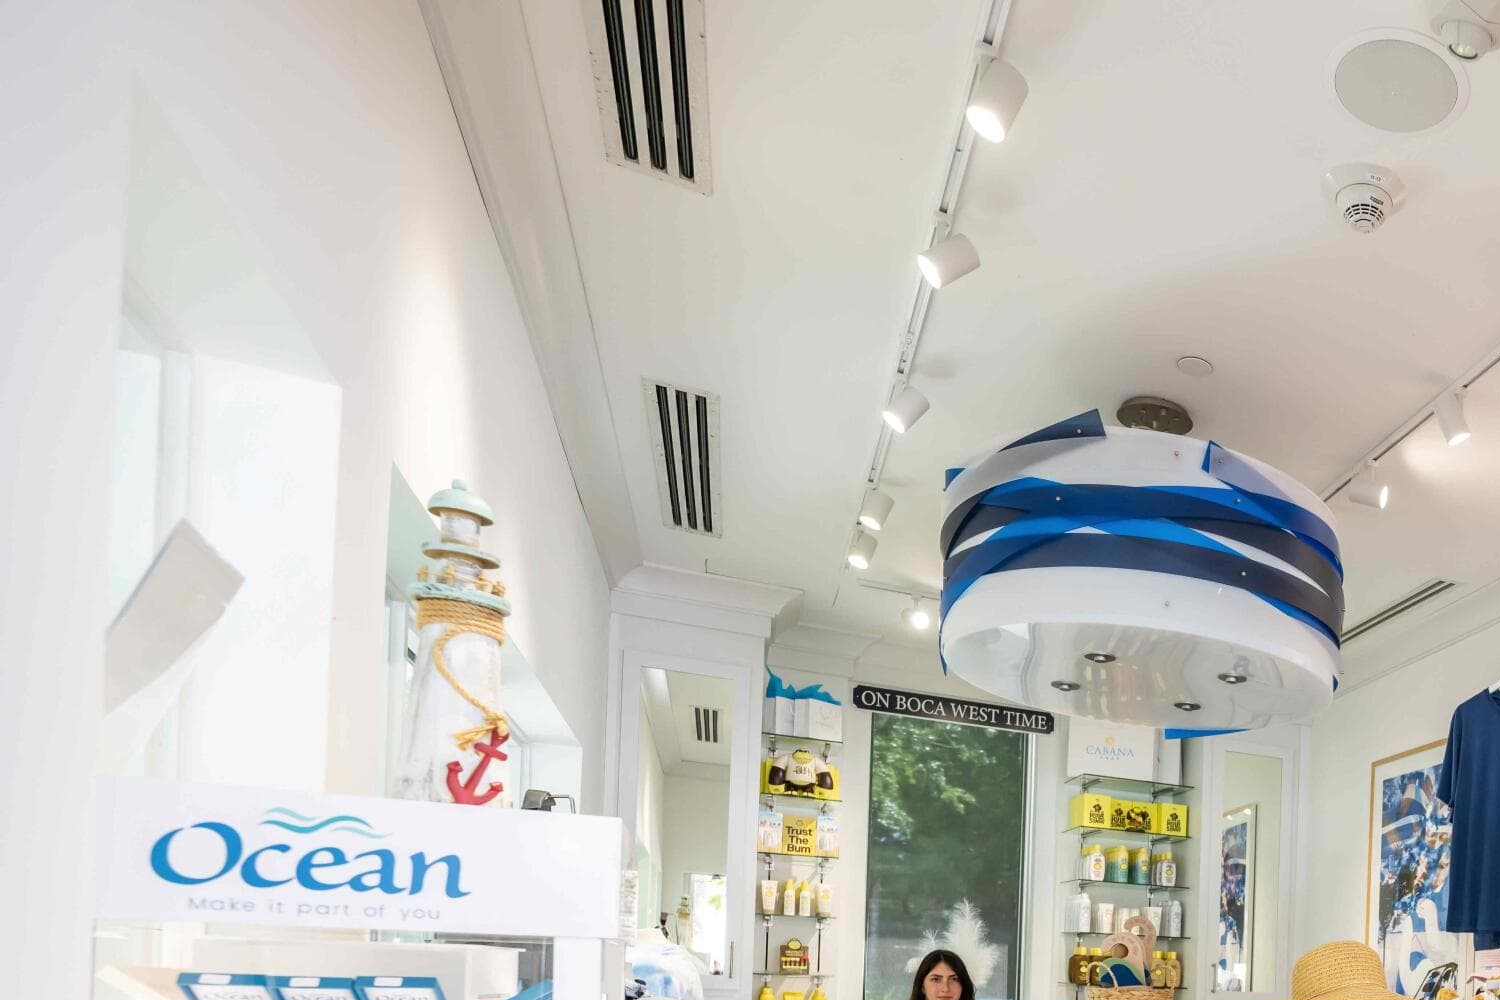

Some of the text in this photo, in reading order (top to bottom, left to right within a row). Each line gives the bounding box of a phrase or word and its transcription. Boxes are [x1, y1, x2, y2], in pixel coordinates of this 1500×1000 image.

[861, 690, 1048, 730] ON BOCA WEST TIME
[1086, 744, 1135, 758] CABANA
[785, 825, 813, 837] Trust
[788, 835, 809, 845] The
[787, 843, 811, 854] Bum
[151, 821, 472, 898] Ocean
[187, 897, 441, 922] Make it part of you
